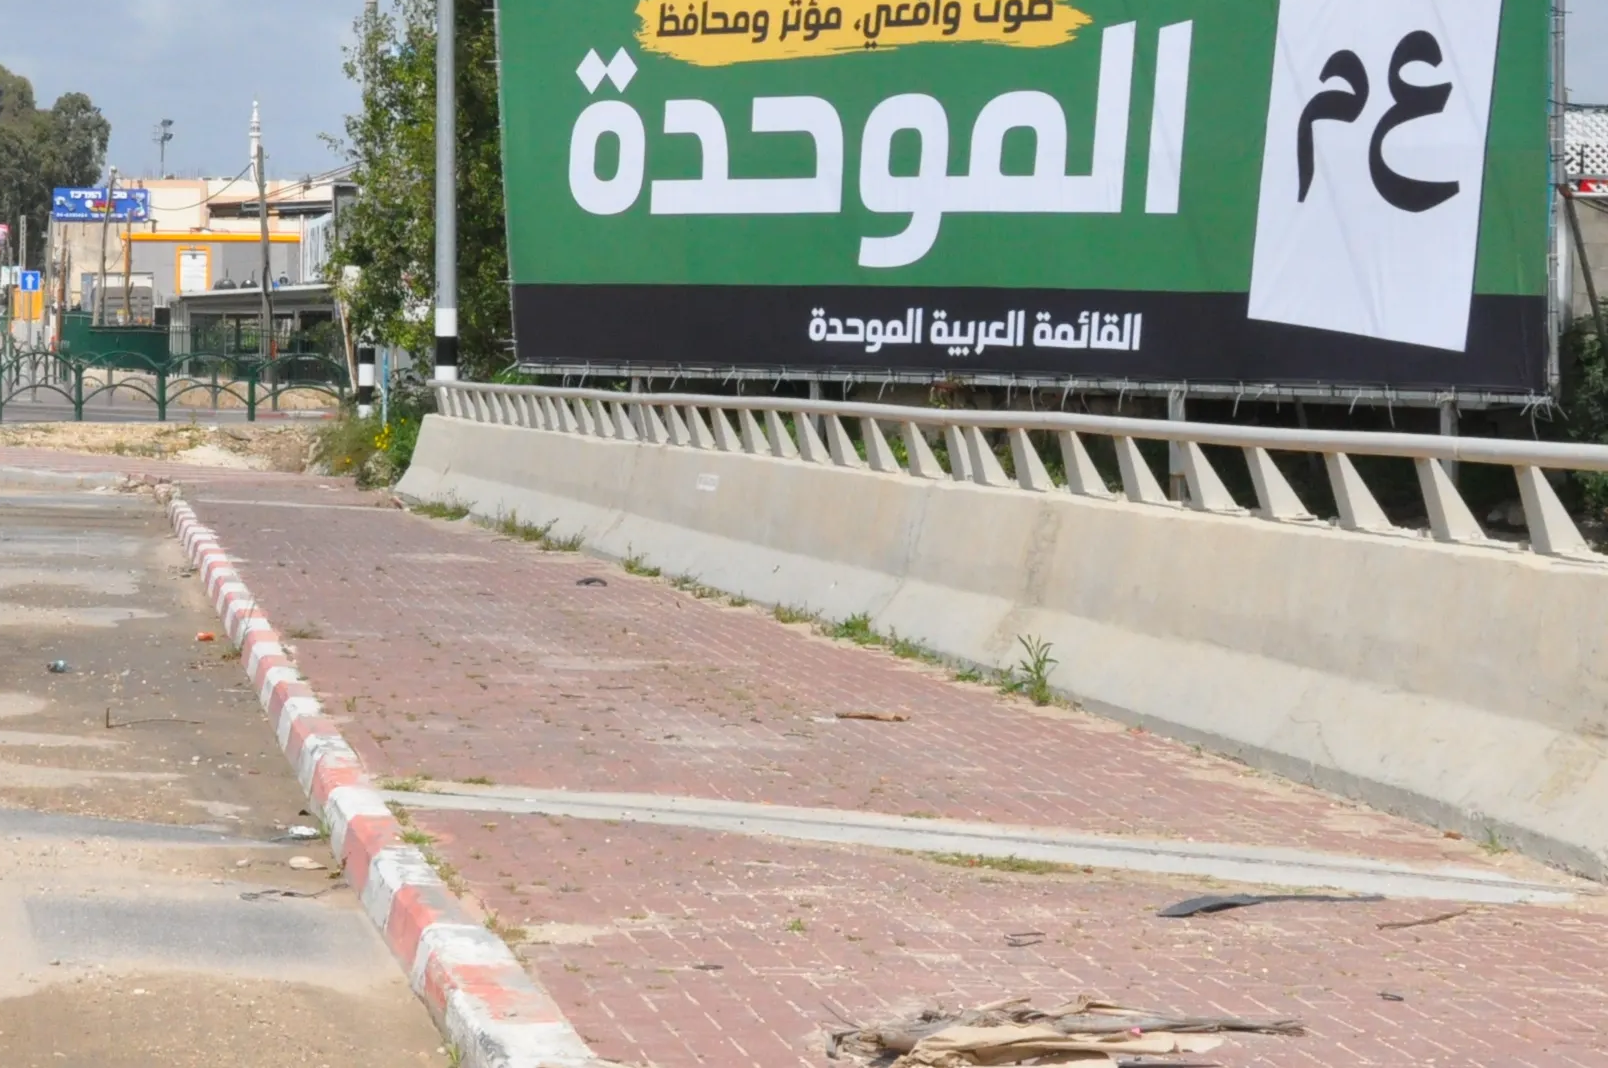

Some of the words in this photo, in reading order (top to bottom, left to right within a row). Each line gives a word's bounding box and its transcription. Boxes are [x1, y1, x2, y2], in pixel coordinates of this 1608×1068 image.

[655, 0, 771, 44] ومحافظ
[568, 18, 1194, 269] الموحدة
[808, 307, 924, 353] الموحدة
[929, 309, 1026, 356] العربية
[1032, 310, 1143, 351] القائمة
